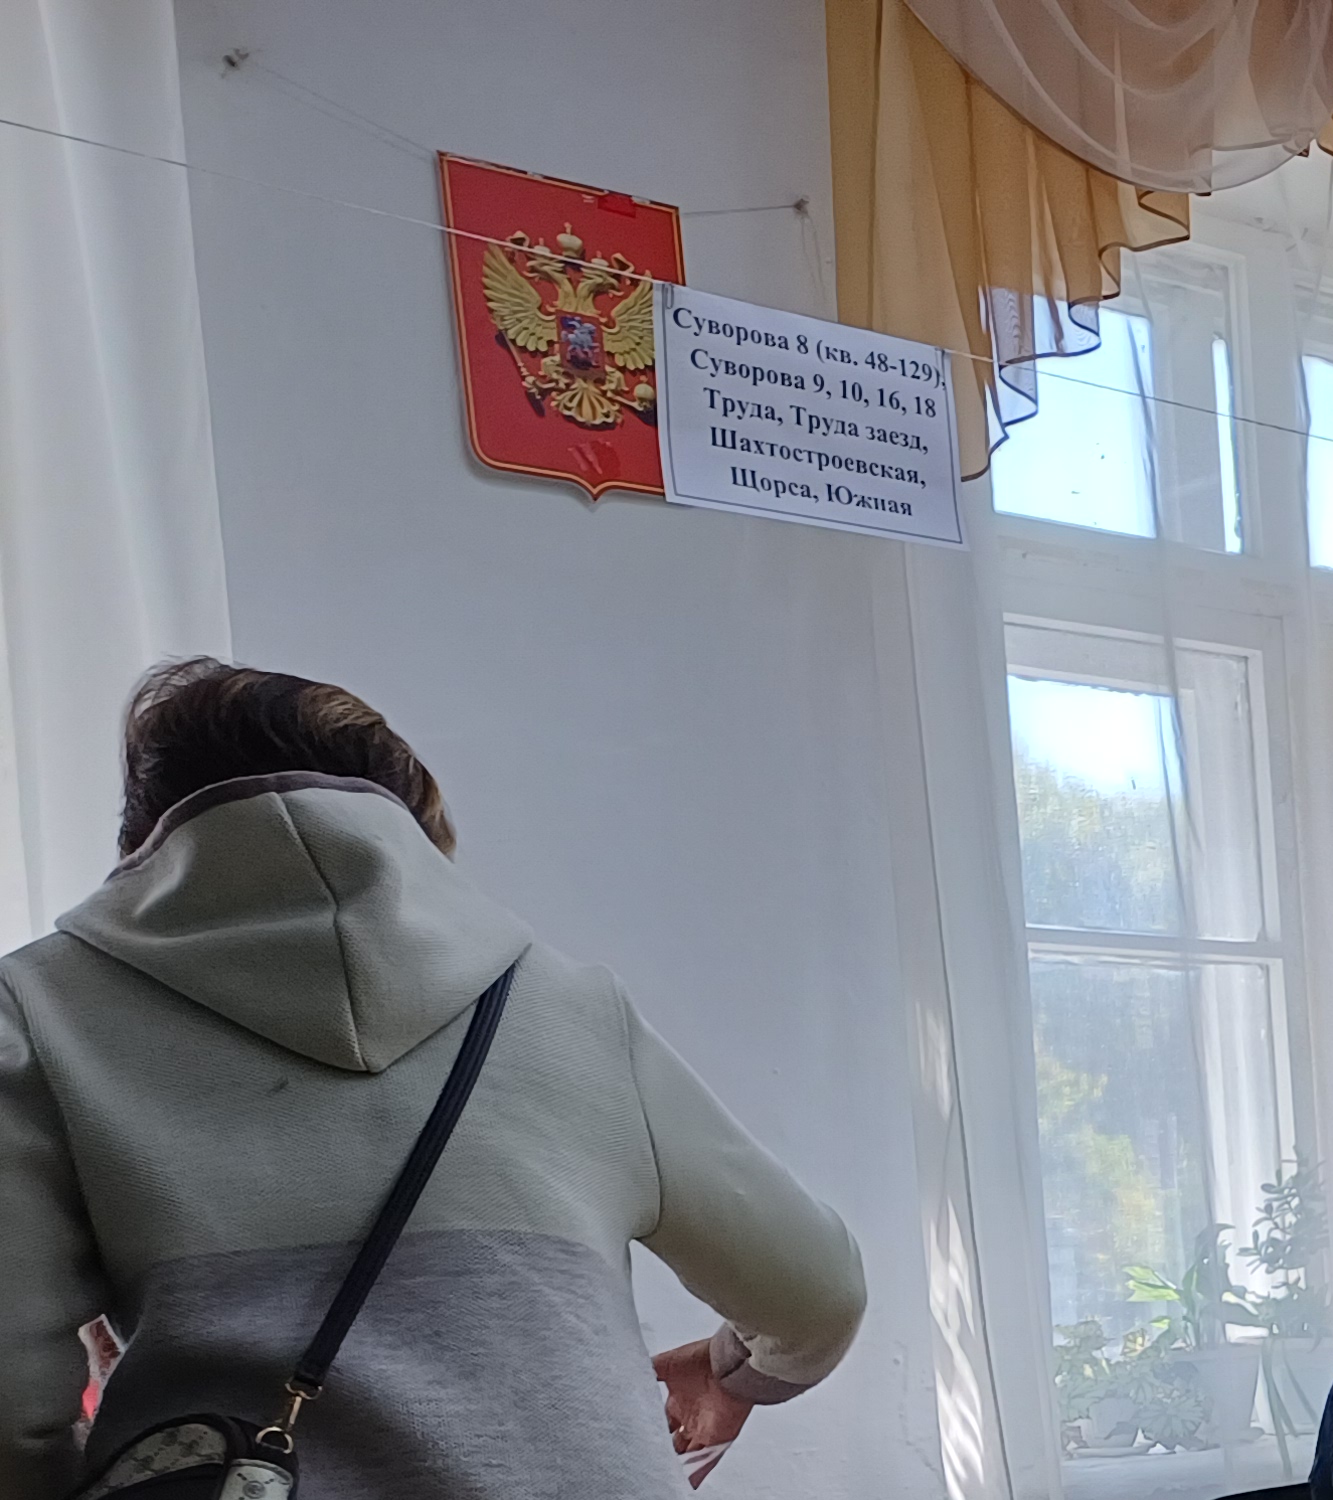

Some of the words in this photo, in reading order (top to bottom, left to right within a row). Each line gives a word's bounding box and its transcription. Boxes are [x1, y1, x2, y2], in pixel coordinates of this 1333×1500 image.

[672, 307, 790, 350] Суворова
[796, 334, 809, 354] 8
[817, 339, 858, 366] (кв.
[864, 350, 946, 390] 48-129),
[690, 348, 805, 390] Суворова
[813, 373, 832, 399] 9,
[839, 379, 869, 407] 10,
[877, 387, 907, 416] 16,
[914, 396, 936, 418] 18
[703, 387, 783, 425] Труда,
[790, 404, 859, 438] Труда
[865, 424, 928, 455] заезд,
[710, 426, 927, 488] Шахтостроевская,
[730, 466, 819, 502] Щорса,
[826, 483, 913, 516] Южная
